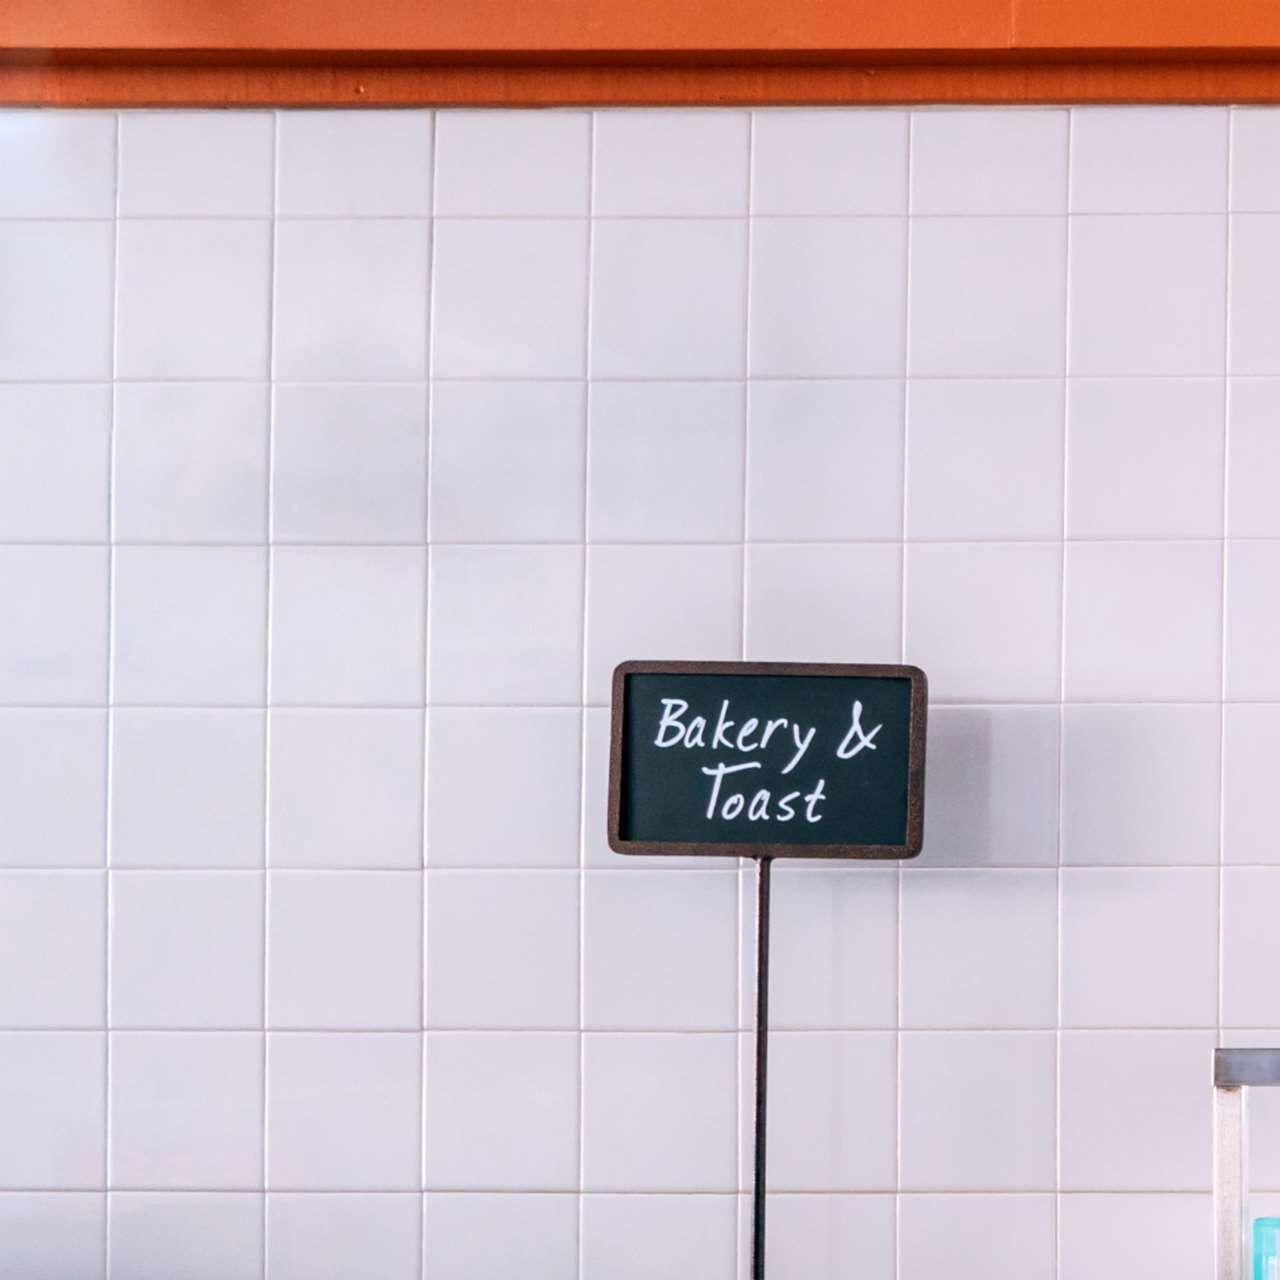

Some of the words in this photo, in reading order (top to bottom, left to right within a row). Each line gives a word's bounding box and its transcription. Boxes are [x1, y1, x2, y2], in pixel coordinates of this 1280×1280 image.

[654, 698, 816, 774] Bakery
[836, 700, 883, 760] &
[701, 762, 827, 823] Toast
